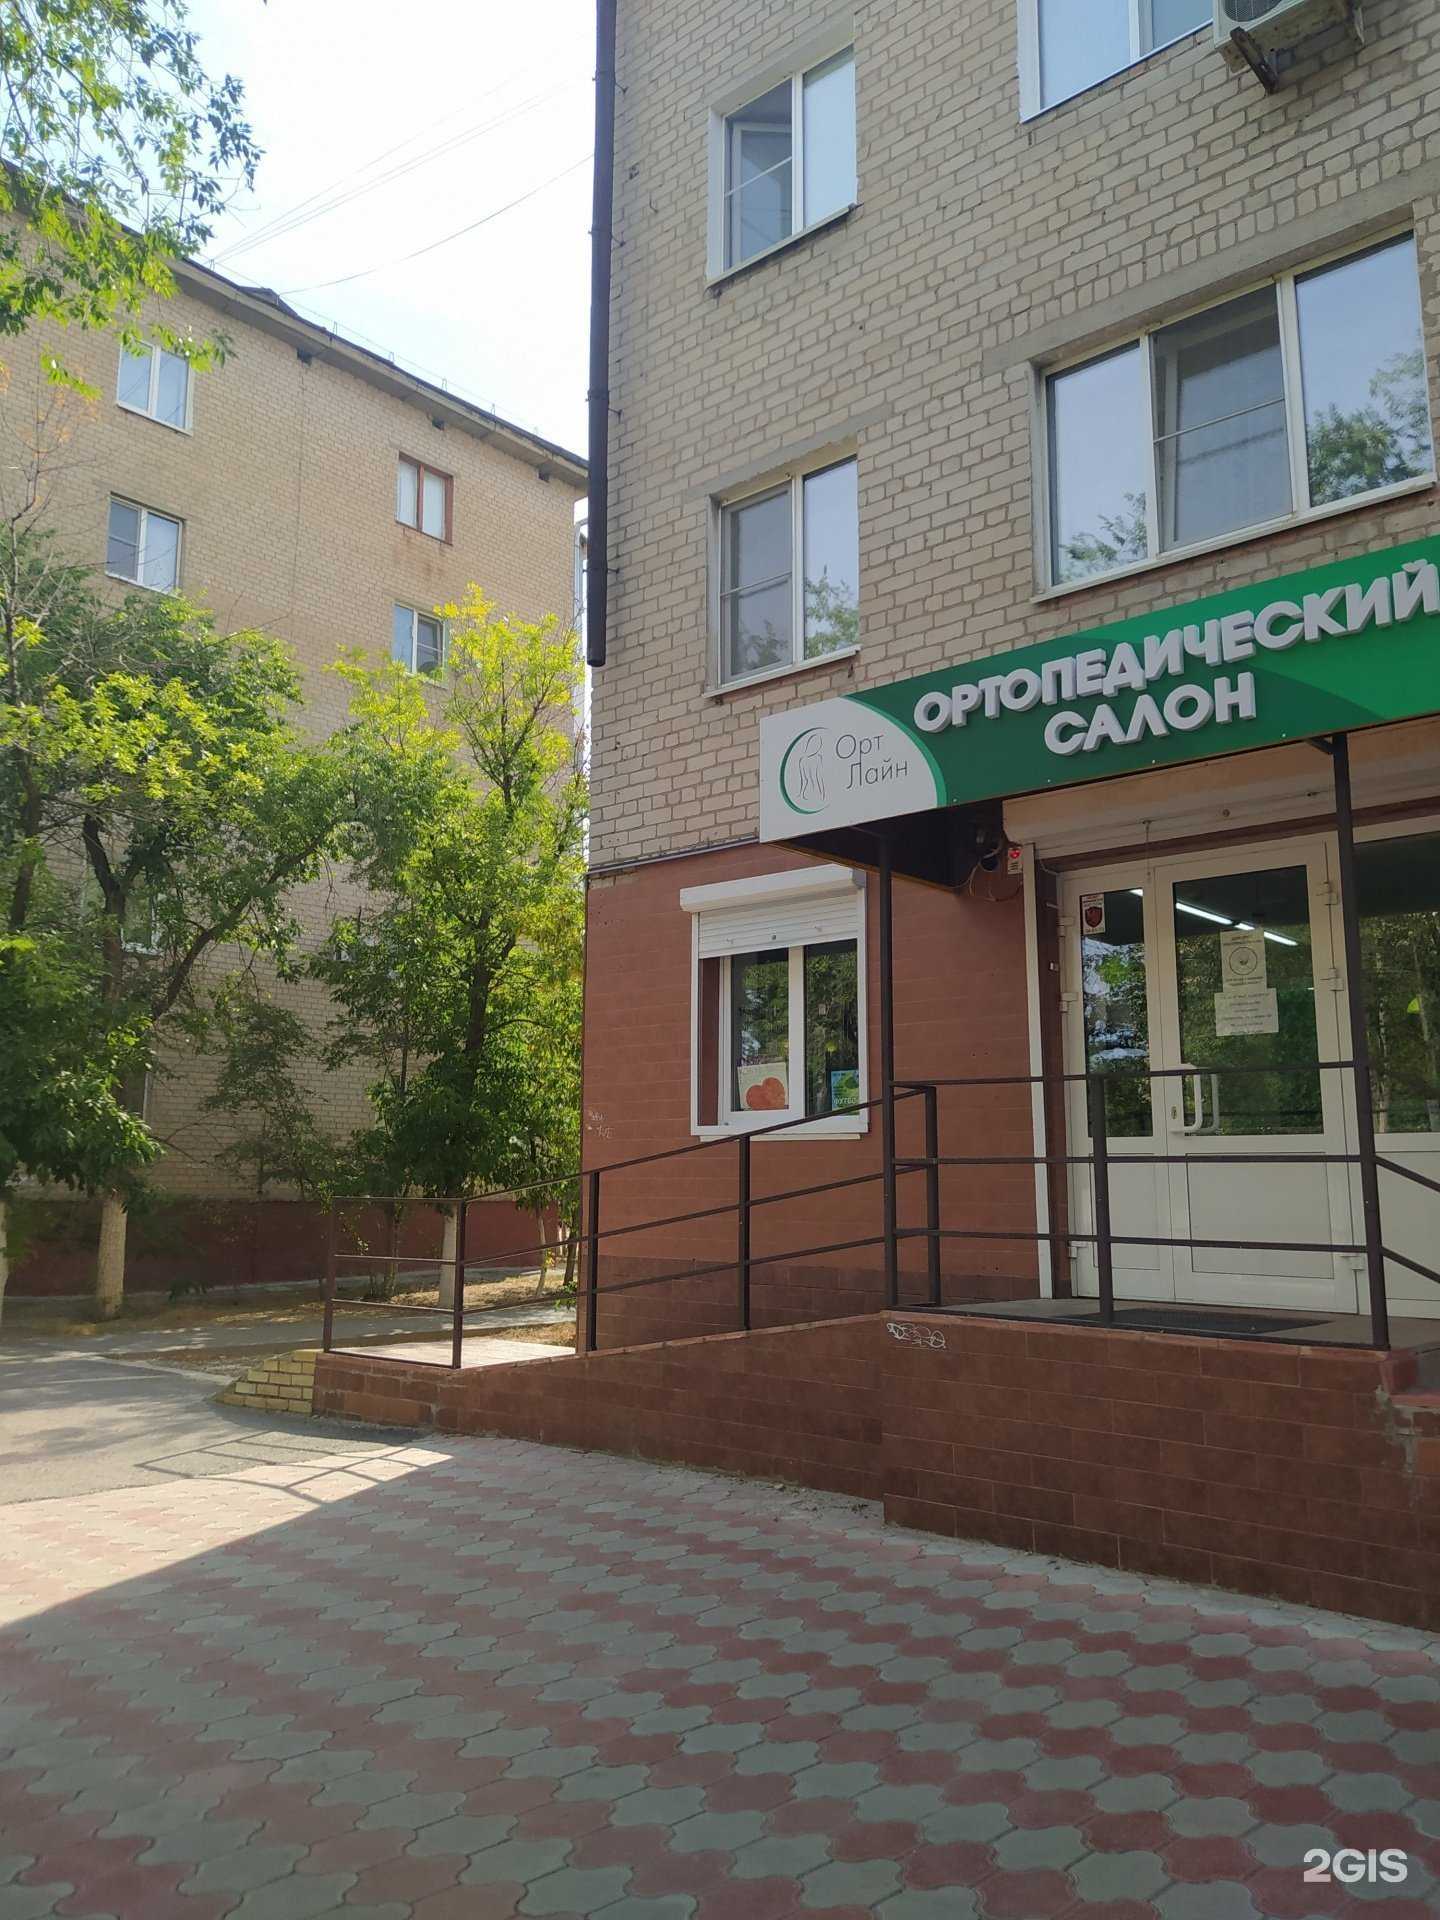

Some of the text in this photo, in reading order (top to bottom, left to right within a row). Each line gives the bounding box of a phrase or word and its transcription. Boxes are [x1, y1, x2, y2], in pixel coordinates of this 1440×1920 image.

[914, 559, 1440, 732] ОРТОПЕДИЧЕСКИЙ
[1044, 672, 1257, 755] САЛОН
[835, 734, 884, 768] Орт
[846, 758, 908, 789] Лайн
